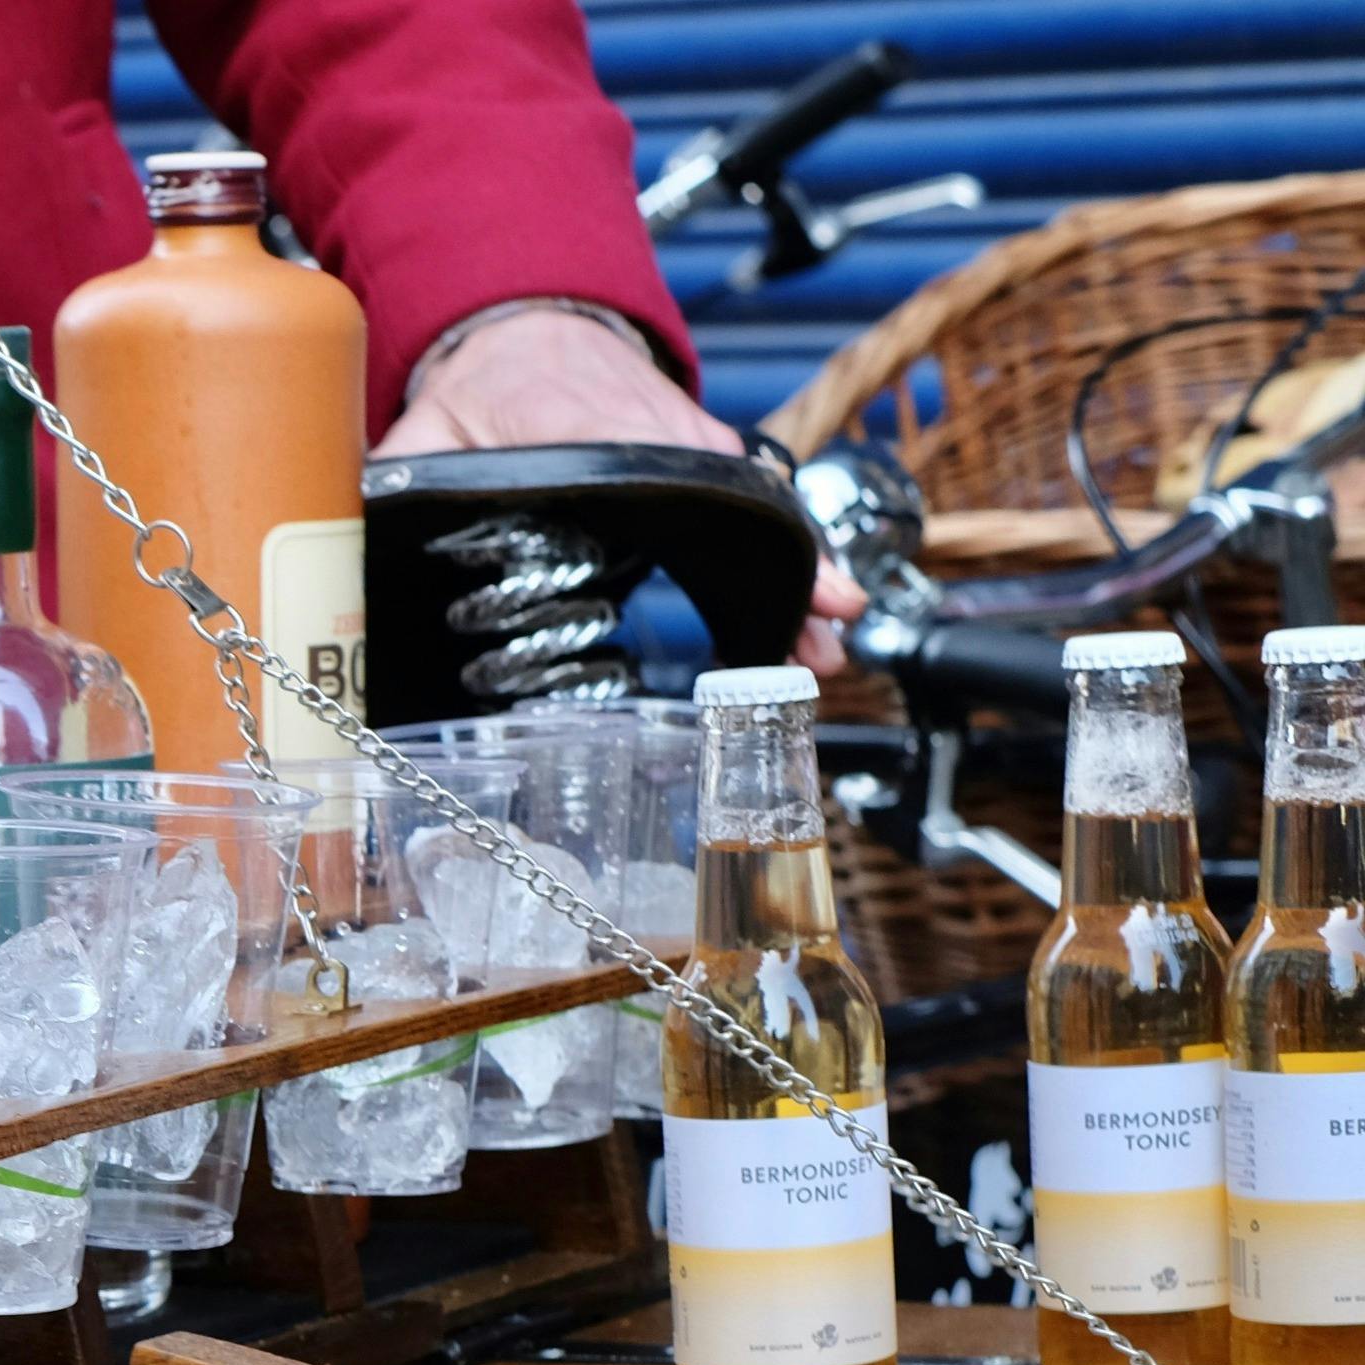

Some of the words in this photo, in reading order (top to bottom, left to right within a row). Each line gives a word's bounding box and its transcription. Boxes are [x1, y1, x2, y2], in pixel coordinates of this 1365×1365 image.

[1084, 1105, 1223, 1131] BERMONDSEY
[1125, 1131, 1191, 1151] TONIC
[741, 1156, 873, 1184] BERMONDSEY
[784, 1183, 848, 1204] TONIC
